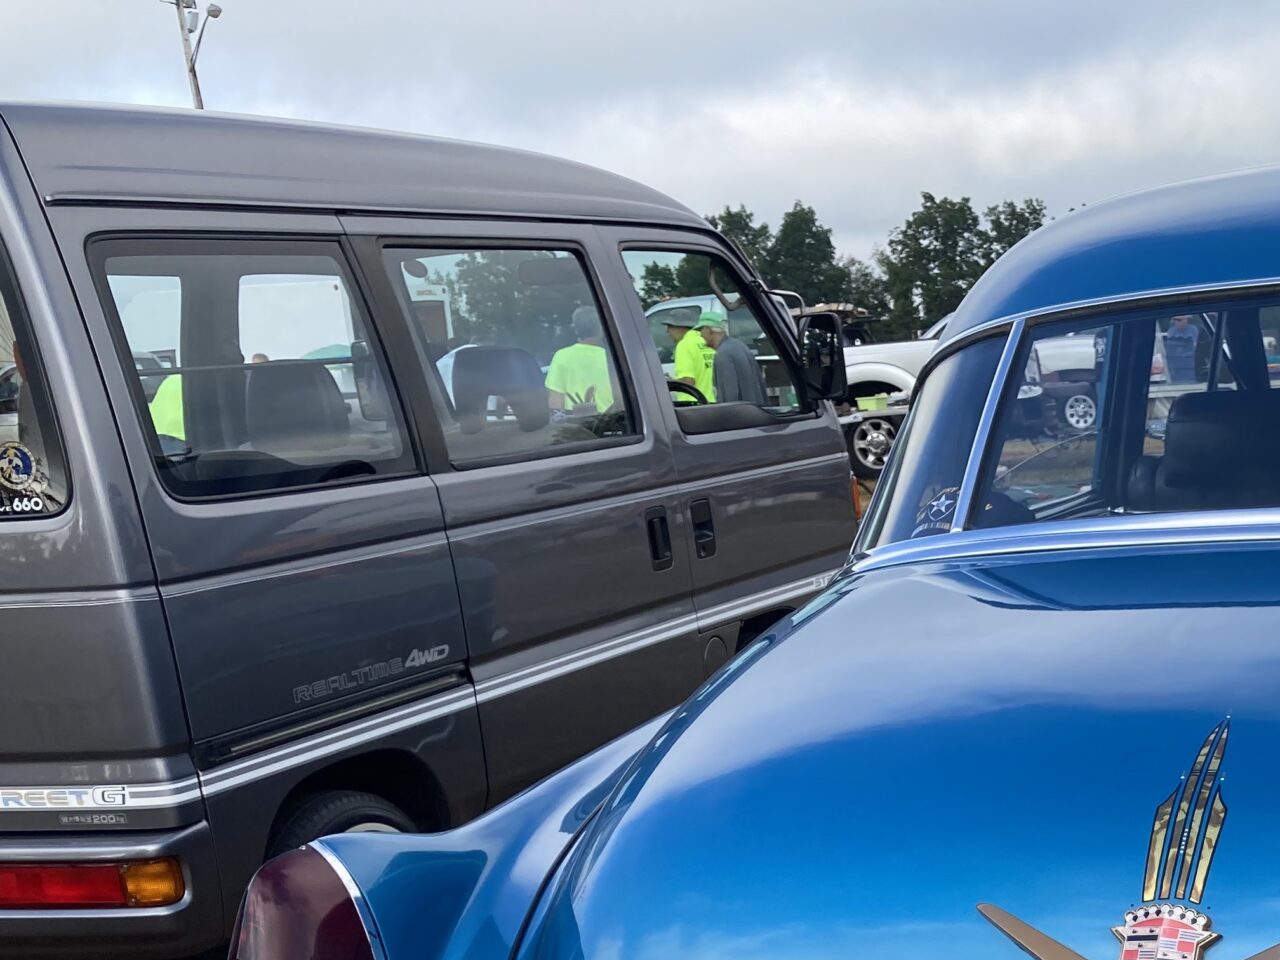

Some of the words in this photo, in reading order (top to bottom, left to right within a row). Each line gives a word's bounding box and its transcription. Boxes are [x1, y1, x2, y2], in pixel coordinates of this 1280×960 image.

[12, 497, 43, 511] 660
[293, 658, 404, 704] REALTIME
[404, 644, 450, 668] 4WD
